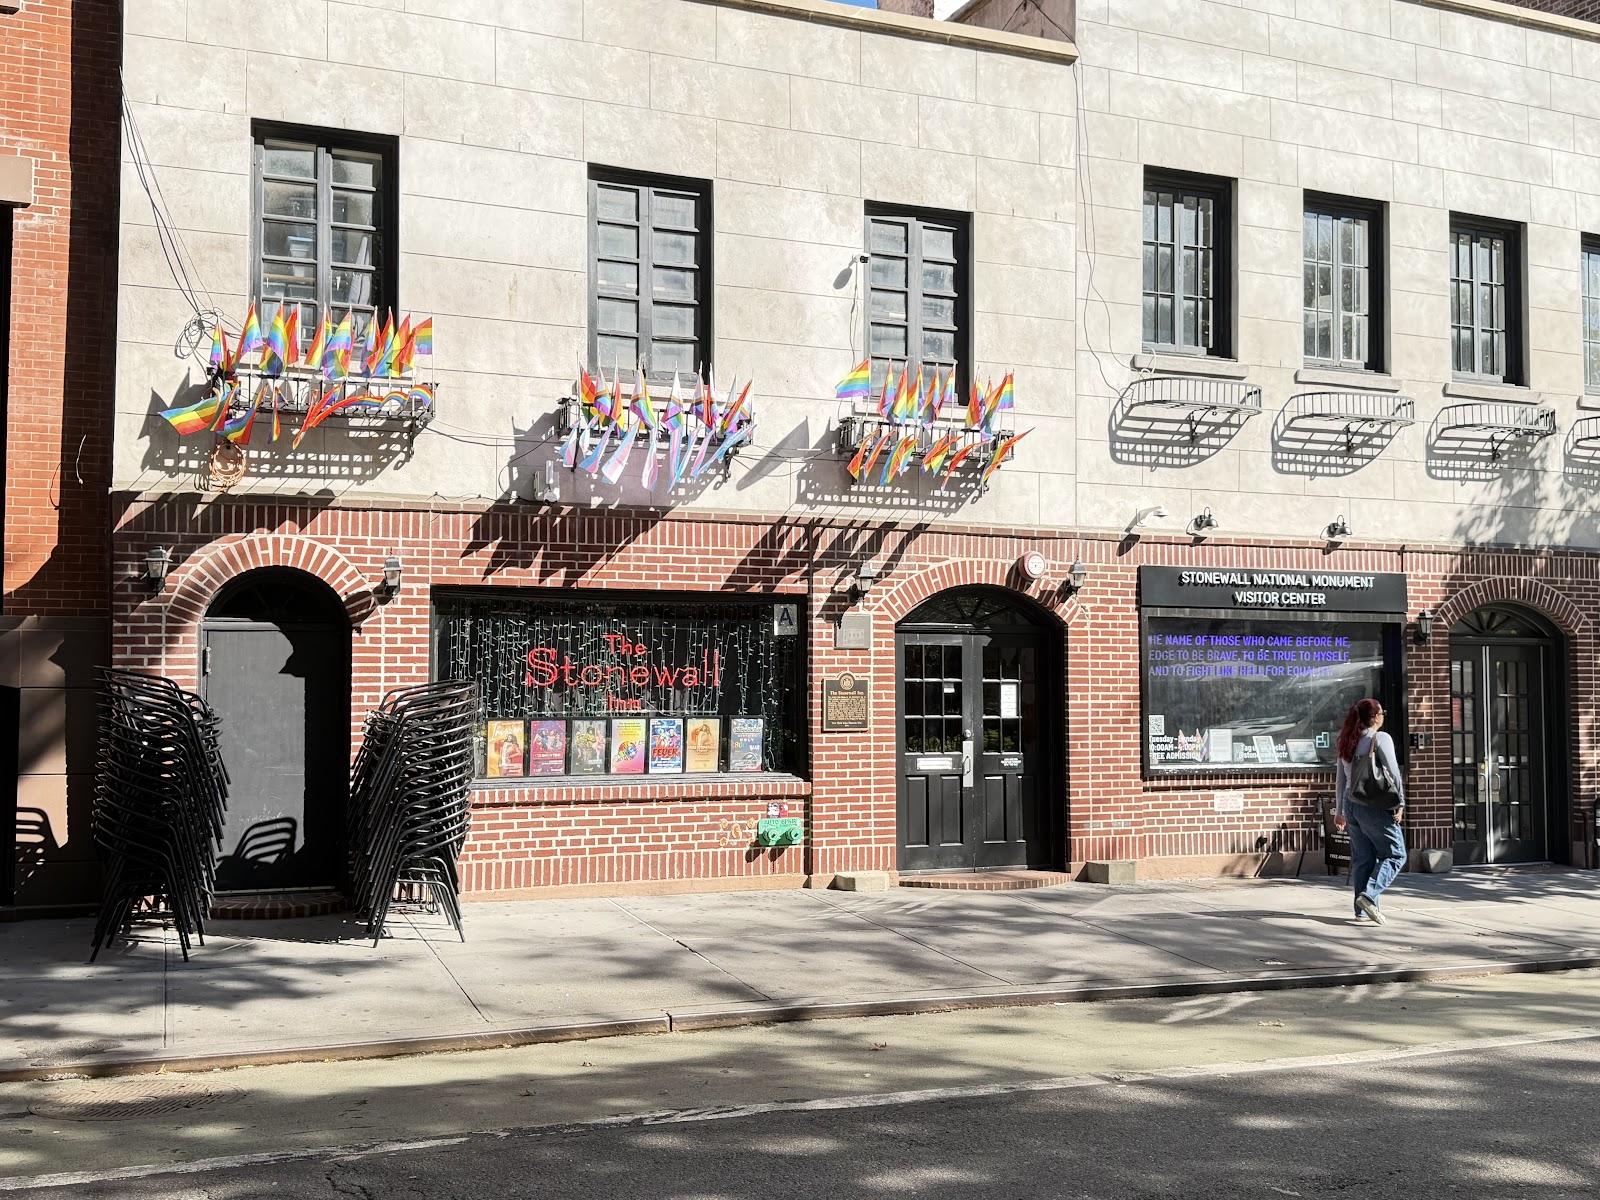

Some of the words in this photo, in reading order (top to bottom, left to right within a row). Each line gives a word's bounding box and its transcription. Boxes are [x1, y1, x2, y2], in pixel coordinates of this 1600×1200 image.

[1181, 570, 1251, 585] STONEWALL
[1253, 573, 1310, 588] NATIONAL
[1312, 574, 1375, 589] MONUMENT
[1235, 591, 1279, 604] VISITOR
[1282, 592, 1326, 605] CENTER
[778, 607, 793, 626] A
[604, 634, 646, 656] The
[1165, 635, 1193, 646] NAME
[1195, 635, 1208, 646] OF
[1209, 635, 1241, 646] THOSE
[1243, 636, 1265, 646] WHO
[1267, 636, 1293, 646] CAME
[1296, 637, 1332, 647] BEFORE
[1335, 637, 1350, 648] ME,
[1176, 650, 1190, 660] TO
[1192, 650, 1204, 661] BE
[1207, 650, 1241, 662] BRAVE,
[1242, 650, 1255, 661] TO
[1257, 650, 1270, 661] BE
[1271, 650, 1296, 661] TRUE
[1298, 651, 1311, 661] TO
[526, 647, 720, 688] Stonewall
[1149, 665, 1169, 676] AND
[1171, 666, 1185, 676] TO
[1186, 666, 1214, 676] FIGHT
[1216, 666, 1237, 676] LIKE
[1240, 666, 1264, 676] HELL
[1265, 666, 1285, 676] FOR
[607, 691, 642, 712] Inn
[1166, 752, 1200, 760] ADMISSION
